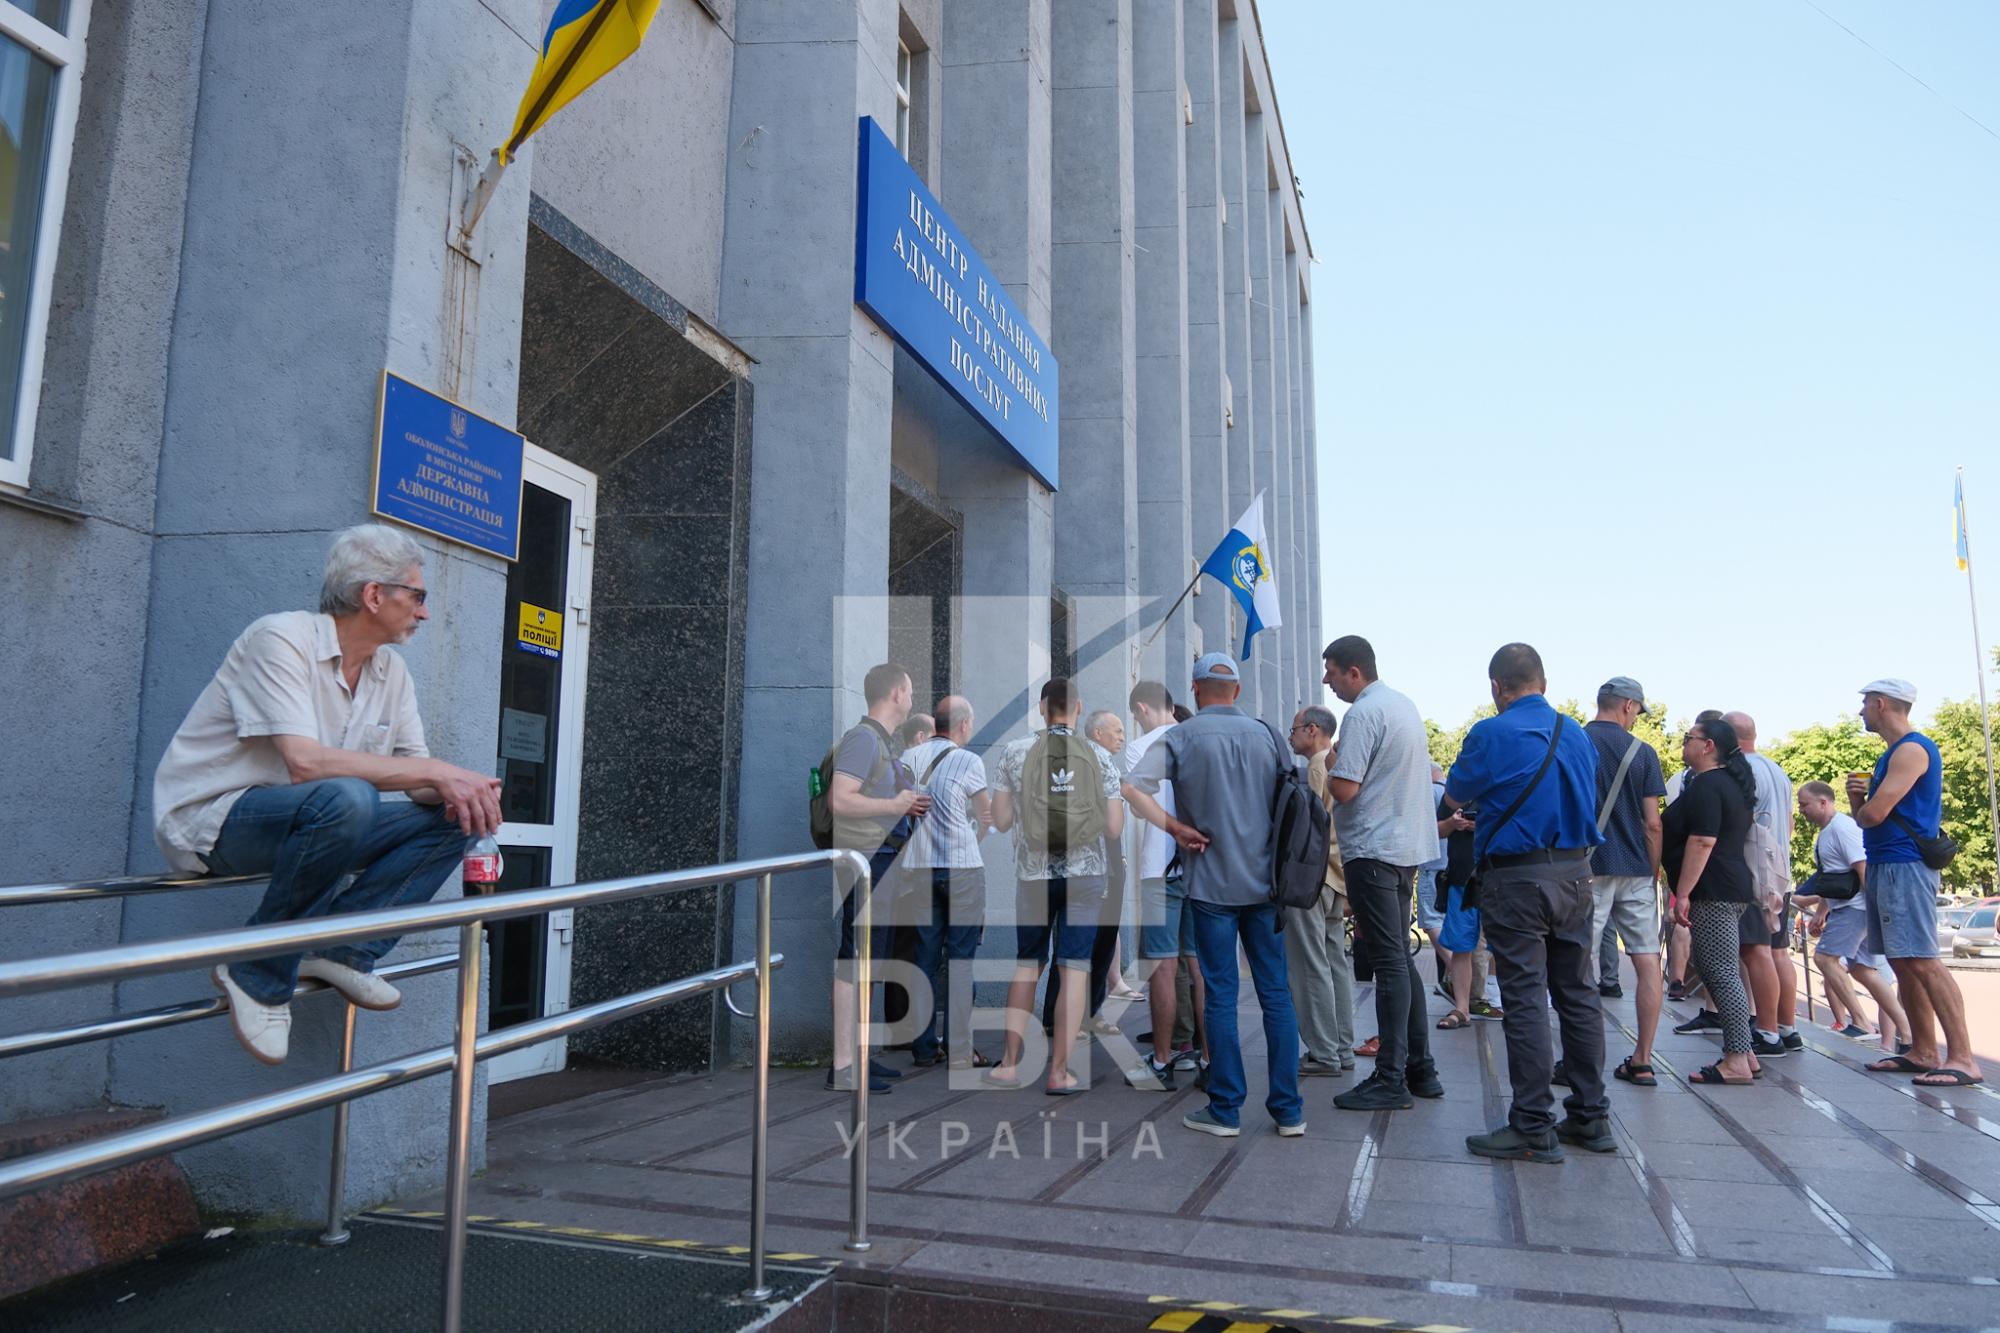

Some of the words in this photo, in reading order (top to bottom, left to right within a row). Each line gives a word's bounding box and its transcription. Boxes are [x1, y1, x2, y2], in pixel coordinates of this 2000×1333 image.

[909, 189, 968, 281] ЦЕНТР
[978, 275, 1041, 375] НАДАННЯ
[893, 226, 1049, 423] АДМІНІСТРАТИВНИХ
[950, 336, 1013, 421] ПОСЛУГ
[397, 478, 504, 528] АДМІНІСТРАЦІЯ
[416, 464, 490, 504] ДЕРЖАВНА
[523, 629, 557, 646] ПОЛІЦІЇ
[1050, 784, 1075, 792] adidas
